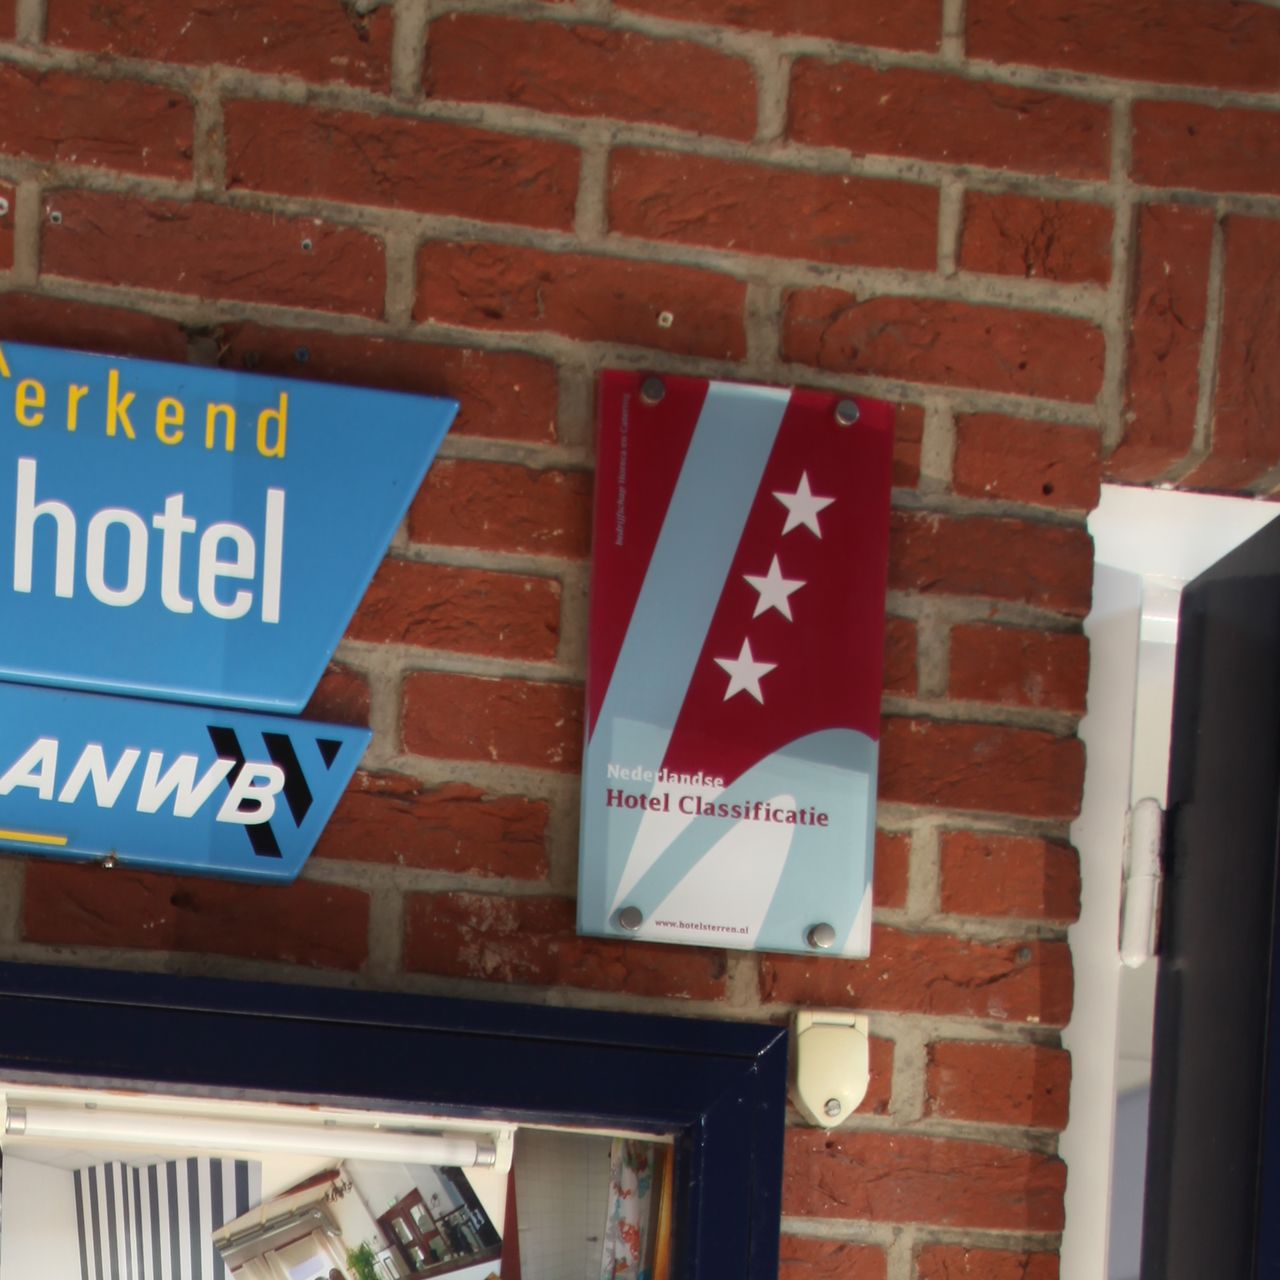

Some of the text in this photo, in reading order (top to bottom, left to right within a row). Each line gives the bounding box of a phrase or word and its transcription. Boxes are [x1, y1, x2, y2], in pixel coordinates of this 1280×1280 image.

[14, 368, 289, 459] erkend
[12, 456, 286, 624] hotel
[606, 763, 725, 788] Nederlandse
[605, 788, 830, 827] Hotel Classificatie
[654, 917, 750, 935] www.hotelsterren.nl
